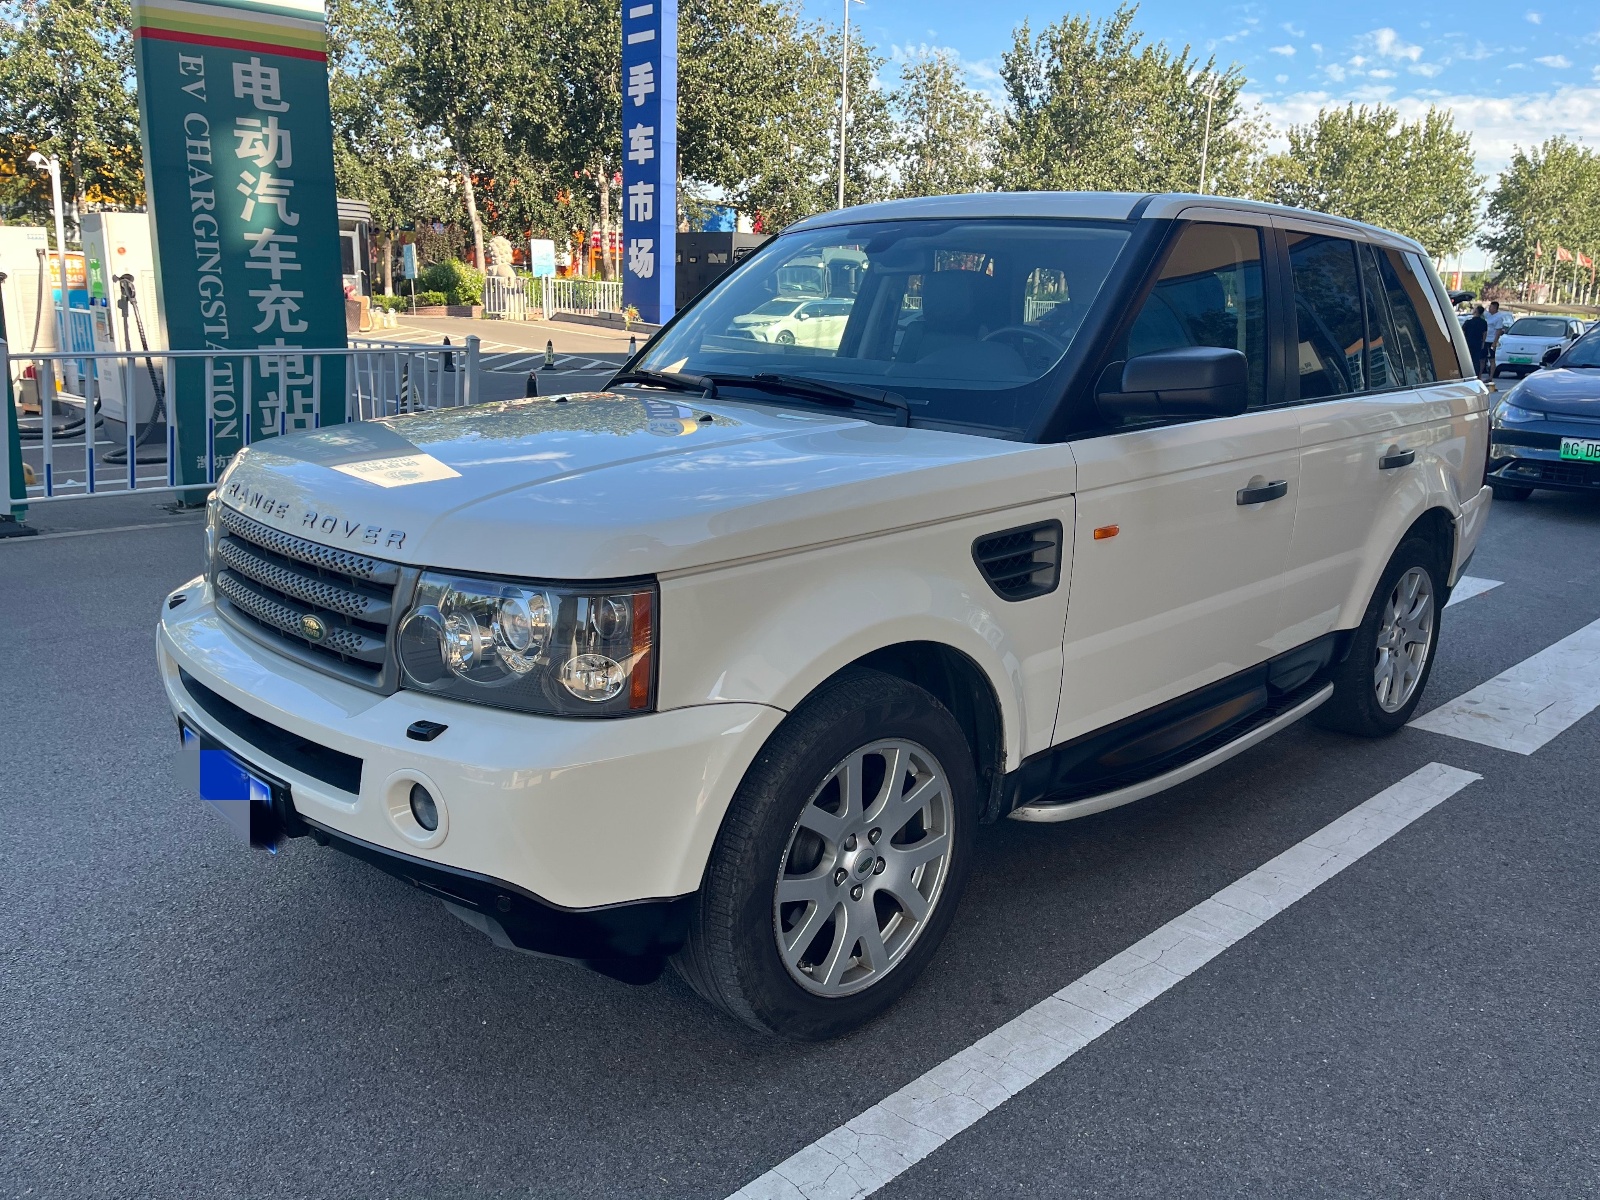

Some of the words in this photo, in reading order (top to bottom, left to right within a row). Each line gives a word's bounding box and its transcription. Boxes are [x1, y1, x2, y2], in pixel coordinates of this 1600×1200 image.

[178, 52, 207, 103] EV
[627, 3, 656, 279] 二手车市场
[232, 56, 315, 434] 电动汽车充电站
[228, 483, 290, 519] RANGE
[301, 511, 407, 550] ROVER
